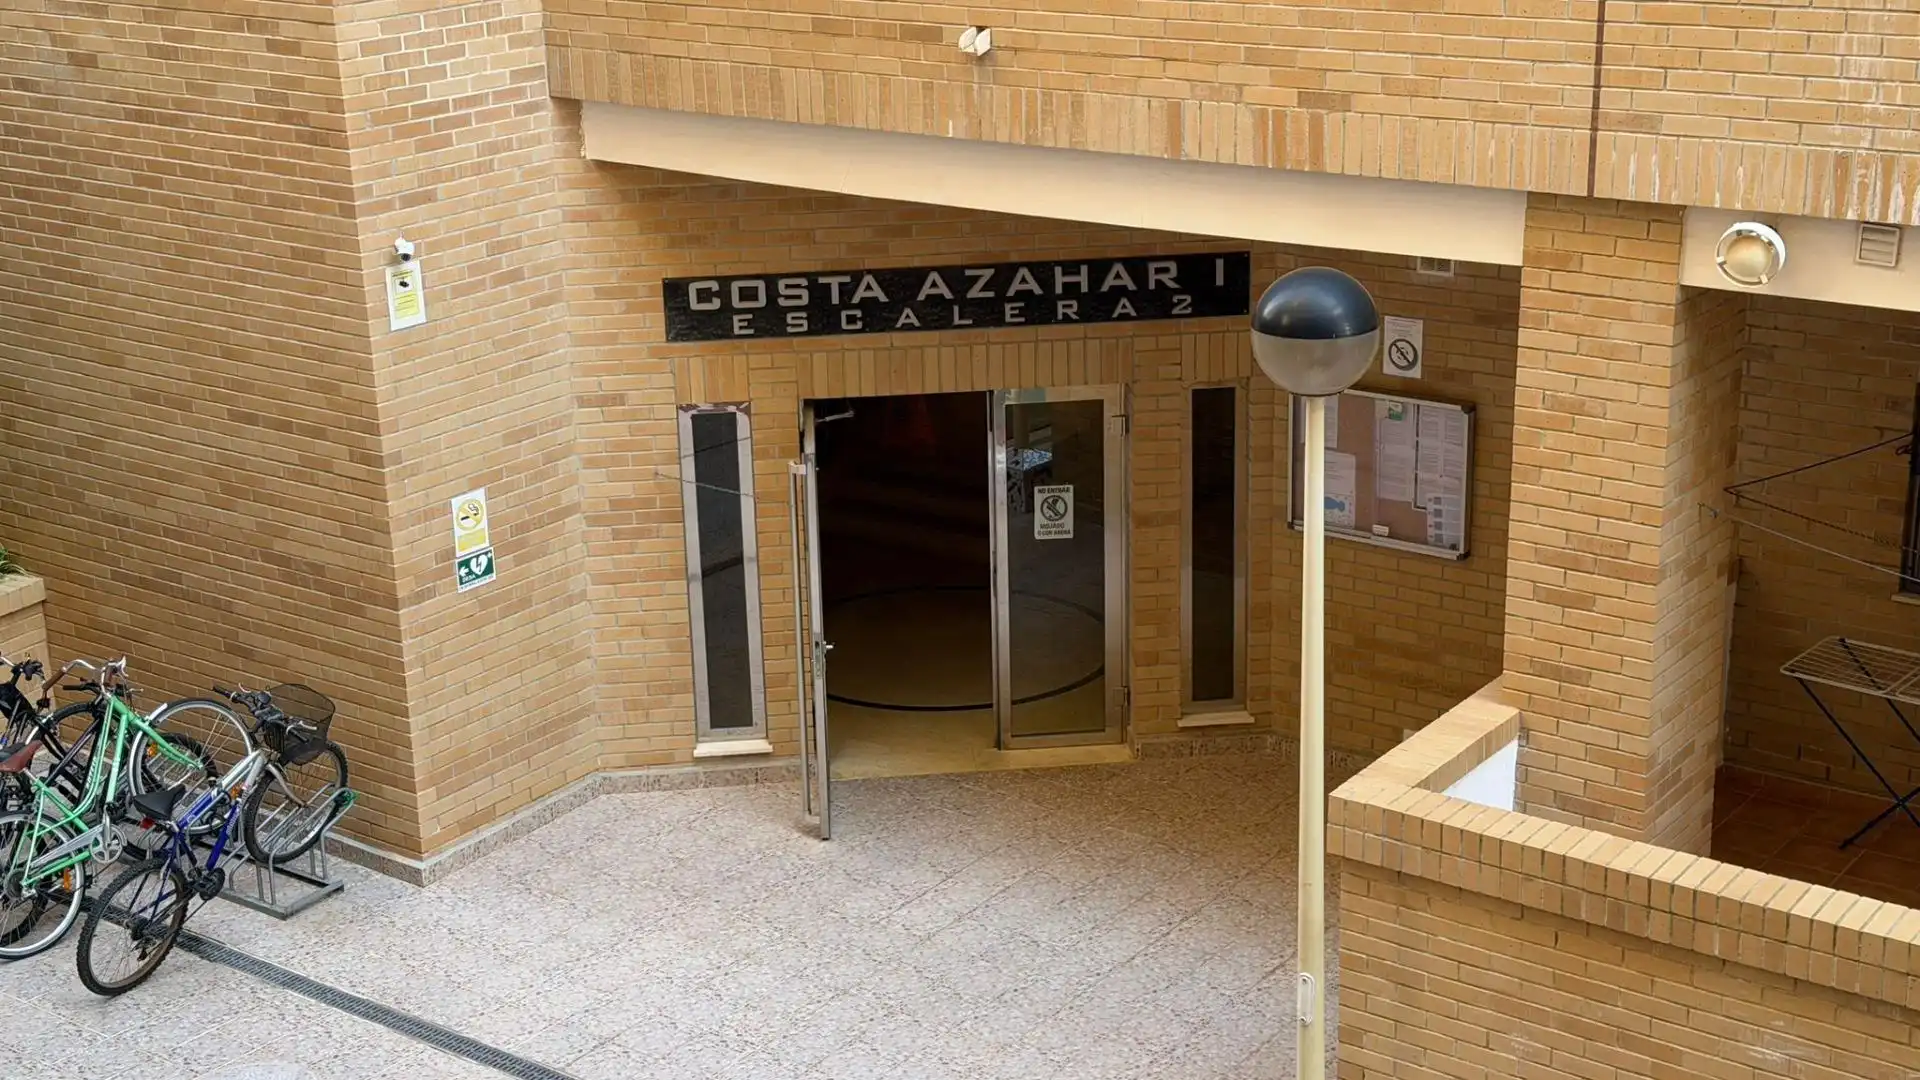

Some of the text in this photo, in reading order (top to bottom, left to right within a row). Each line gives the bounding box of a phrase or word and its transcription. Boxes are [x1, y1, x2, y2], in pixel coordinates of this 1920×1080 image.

[688, 275, 889, 310] COSTA
[916, 260, 1182, 300] AZAHAR
[732, 294, 1193, 335] ESCALERA 2
